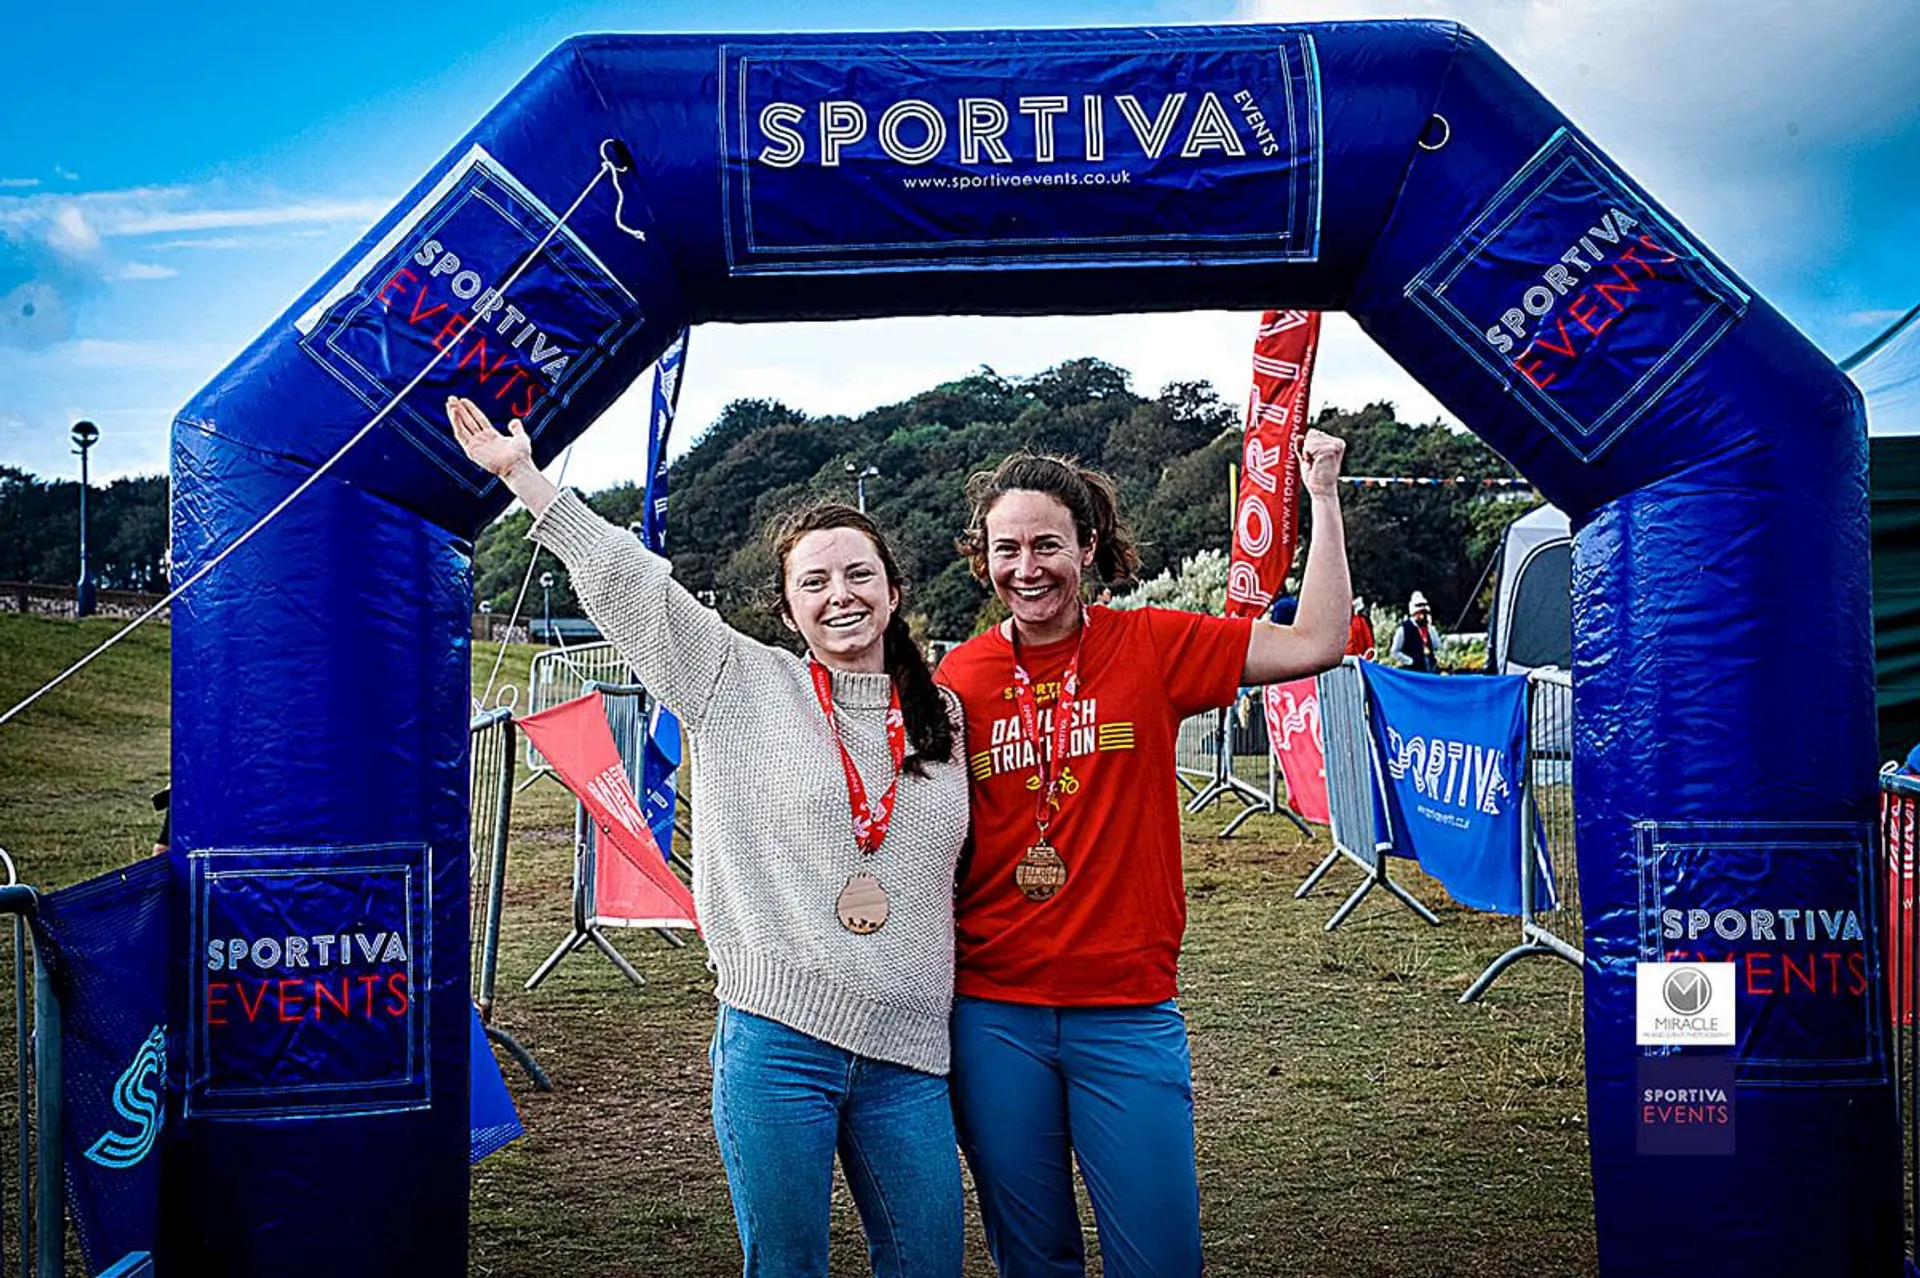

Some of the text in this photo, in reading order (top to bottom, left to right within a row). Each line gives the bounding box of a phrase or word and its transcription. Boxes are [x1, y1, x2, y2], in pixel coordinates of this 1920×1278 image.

[759, 92, 1245, 167] SPORTIVA
[1233, 89, 1279, 157] EVENTS
[902, 170, 1131, 190] www.sportivaevents.co.uk
[1486, 208, 1639, 353] SPORTIVA
[414, 239, 569, 384] SPORTIVA
[1514, 235, 1677, 389] EVENTS
[377, 267, 547, 417] EVENTS
[991, 698, 1097, 746] DALSH
[990, 726, 1096, 774] TRIAON
[207, 931, 408, 970] SPORTIVA
[1662, 909, 1864, 940] SPORTIVA
[207, 972, 409, 1024] EVENTS
[1665, 952, 1867, 996] ENTS
